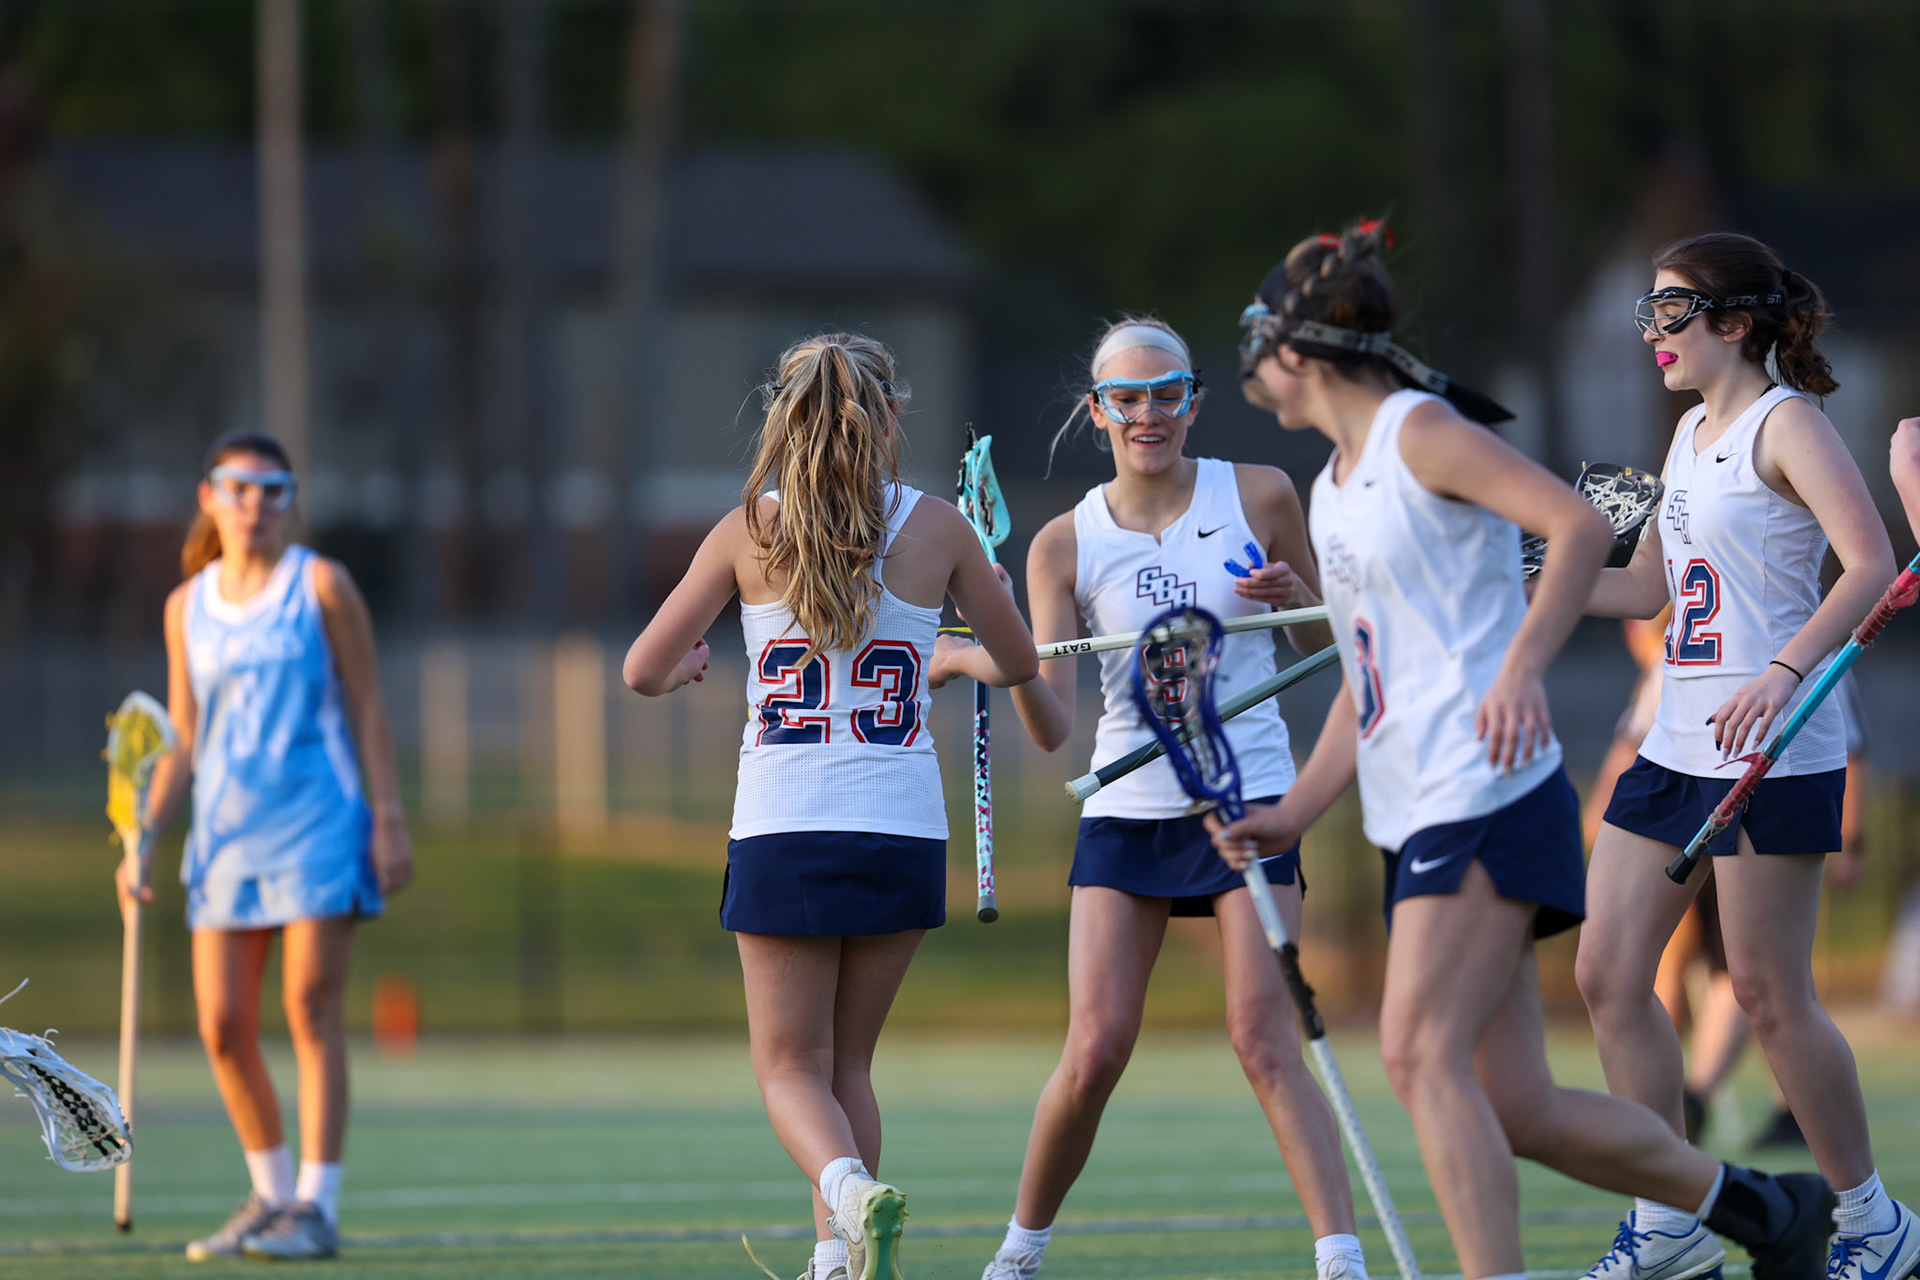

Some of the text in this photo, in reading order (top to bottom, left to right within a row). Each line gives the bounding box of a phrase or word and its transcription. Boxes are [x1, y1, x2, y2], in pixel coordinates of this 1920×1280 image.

[1136, 565, 1196, 611] SBA
[1053, 642, 1091, 656] GAIT
[755, 638, 921, 747] 23
